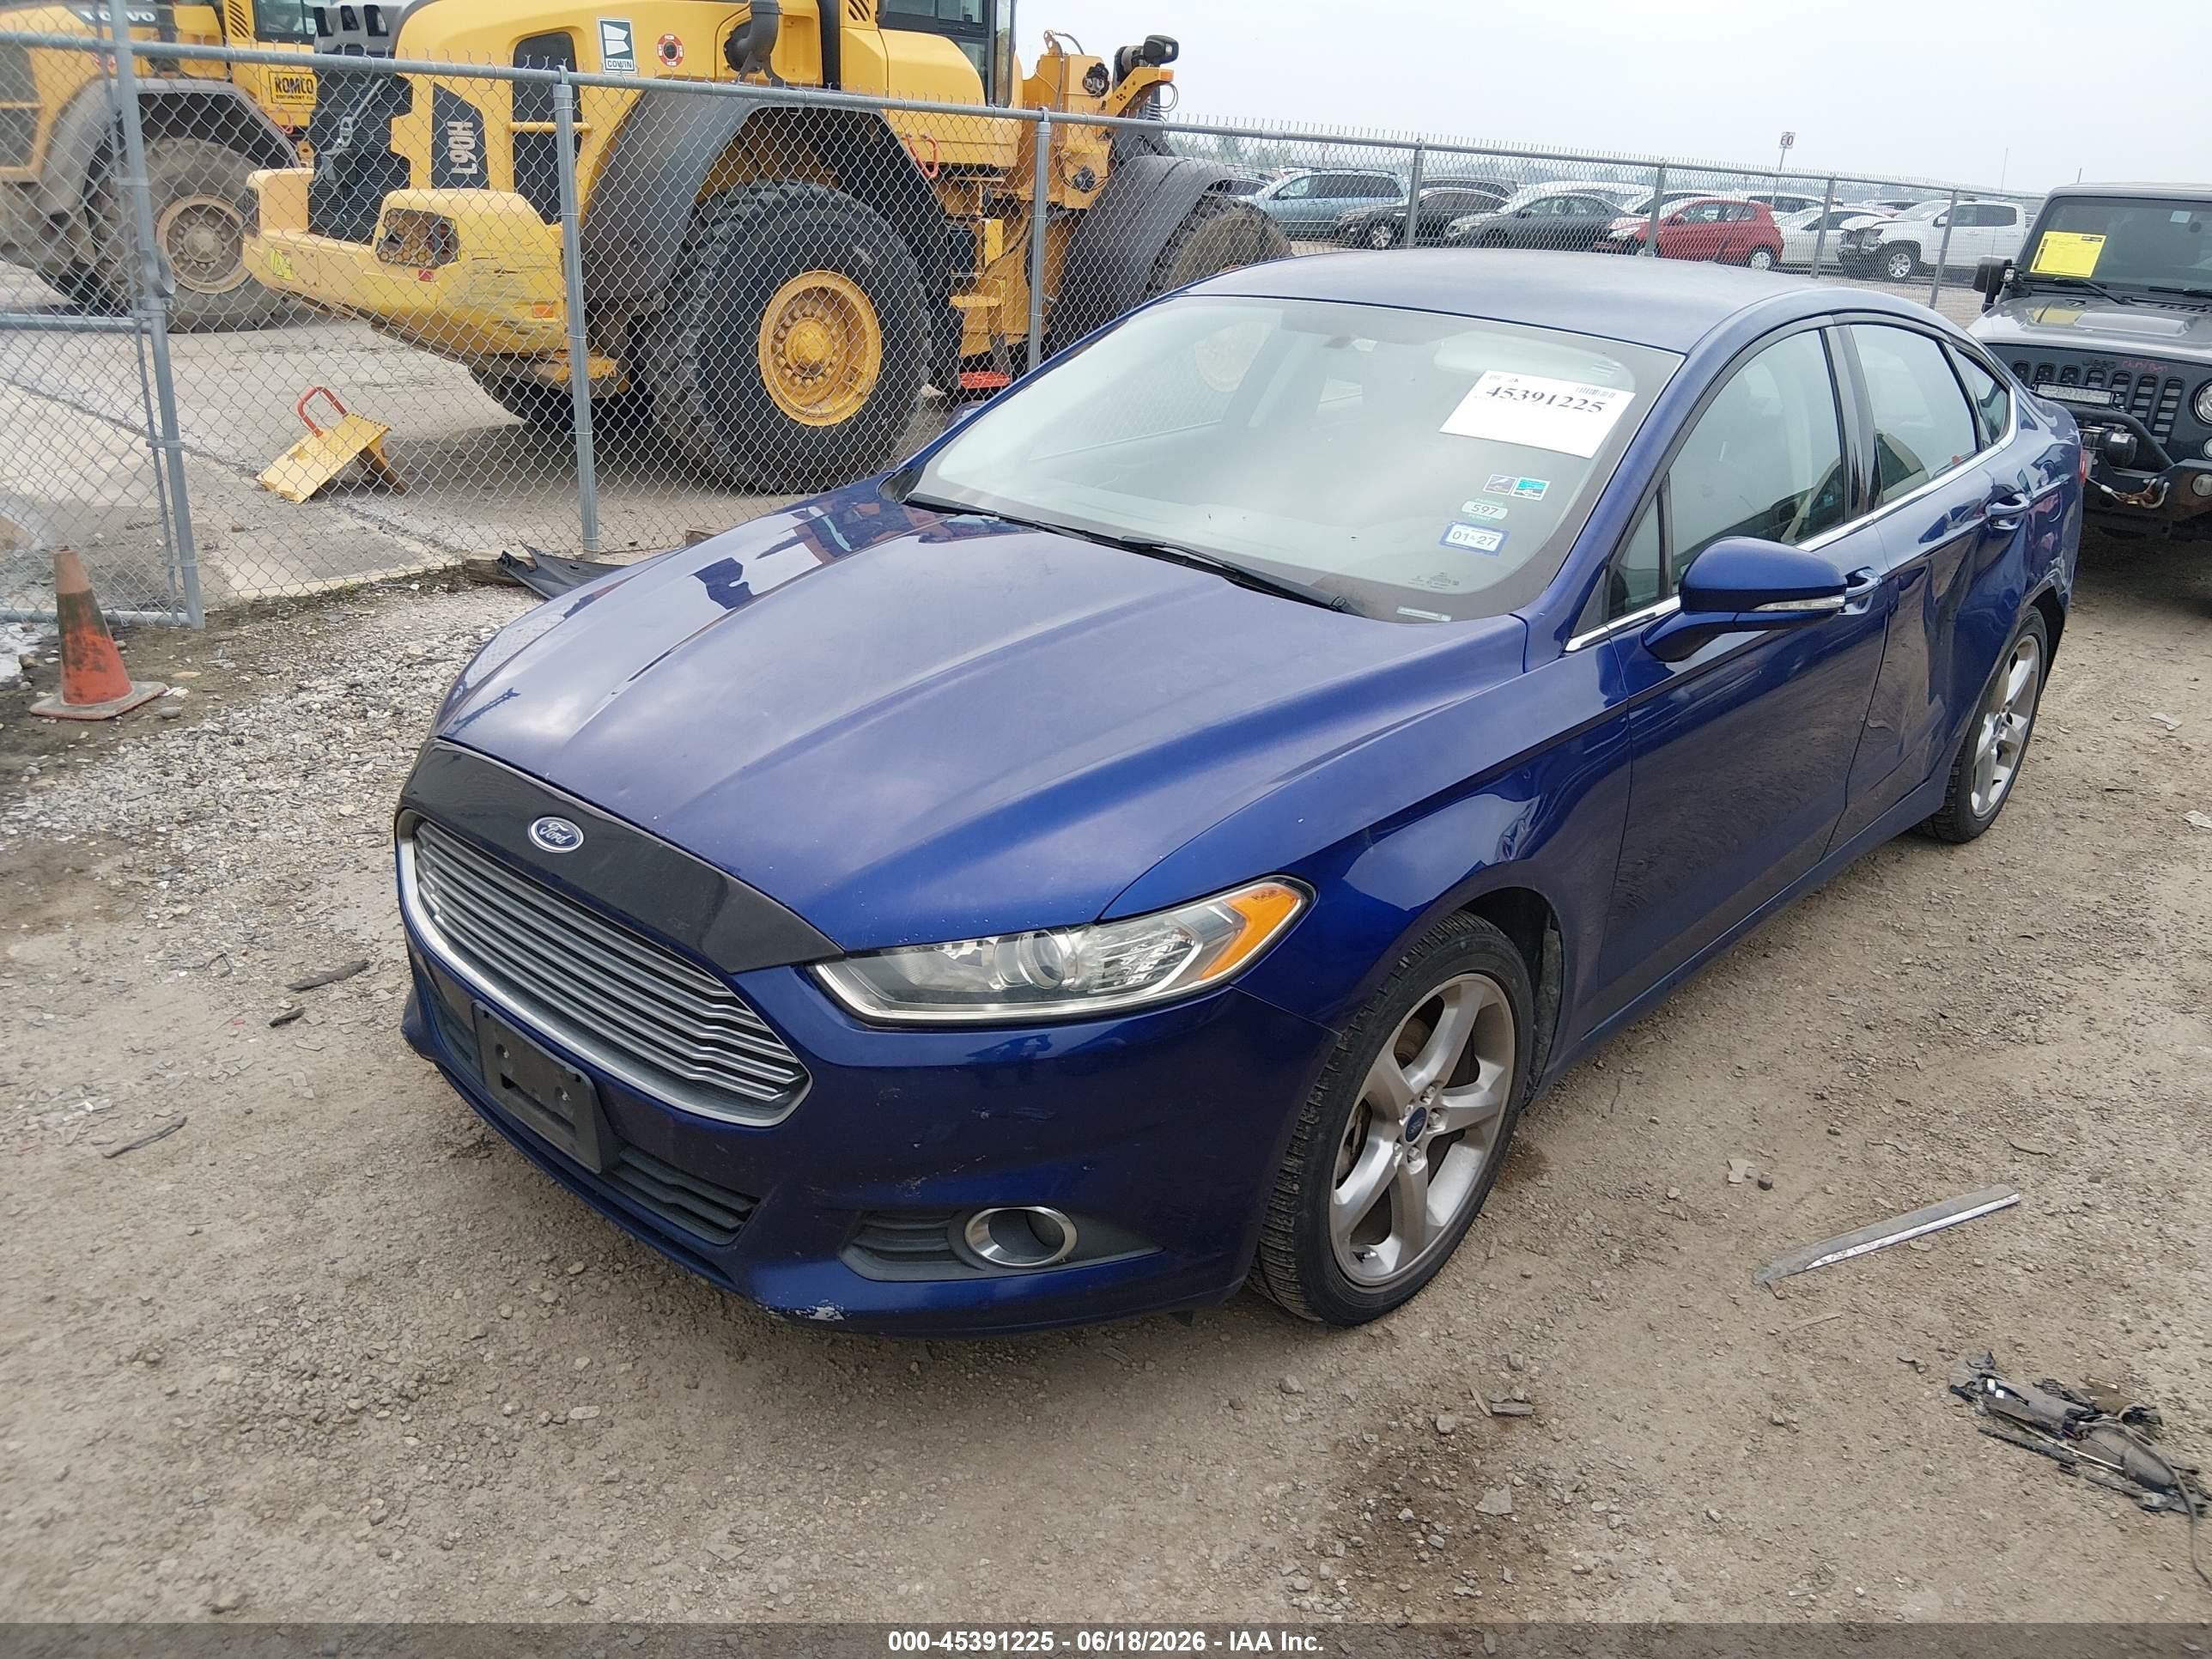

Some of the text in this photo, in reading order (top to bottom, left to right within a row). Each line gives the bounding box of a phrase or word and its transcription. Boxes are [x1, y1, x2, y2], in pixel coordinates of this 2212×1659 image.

[80, 10, 156, 21] VOVO
[275, 77, 314, 94] ROMCO
[447, 121, 478, 174] L90H
[1486, 386, 1607, 413] 45391225
[1471, 504, 1498, 515] 597
[538, 822, 573, 844] Ford
